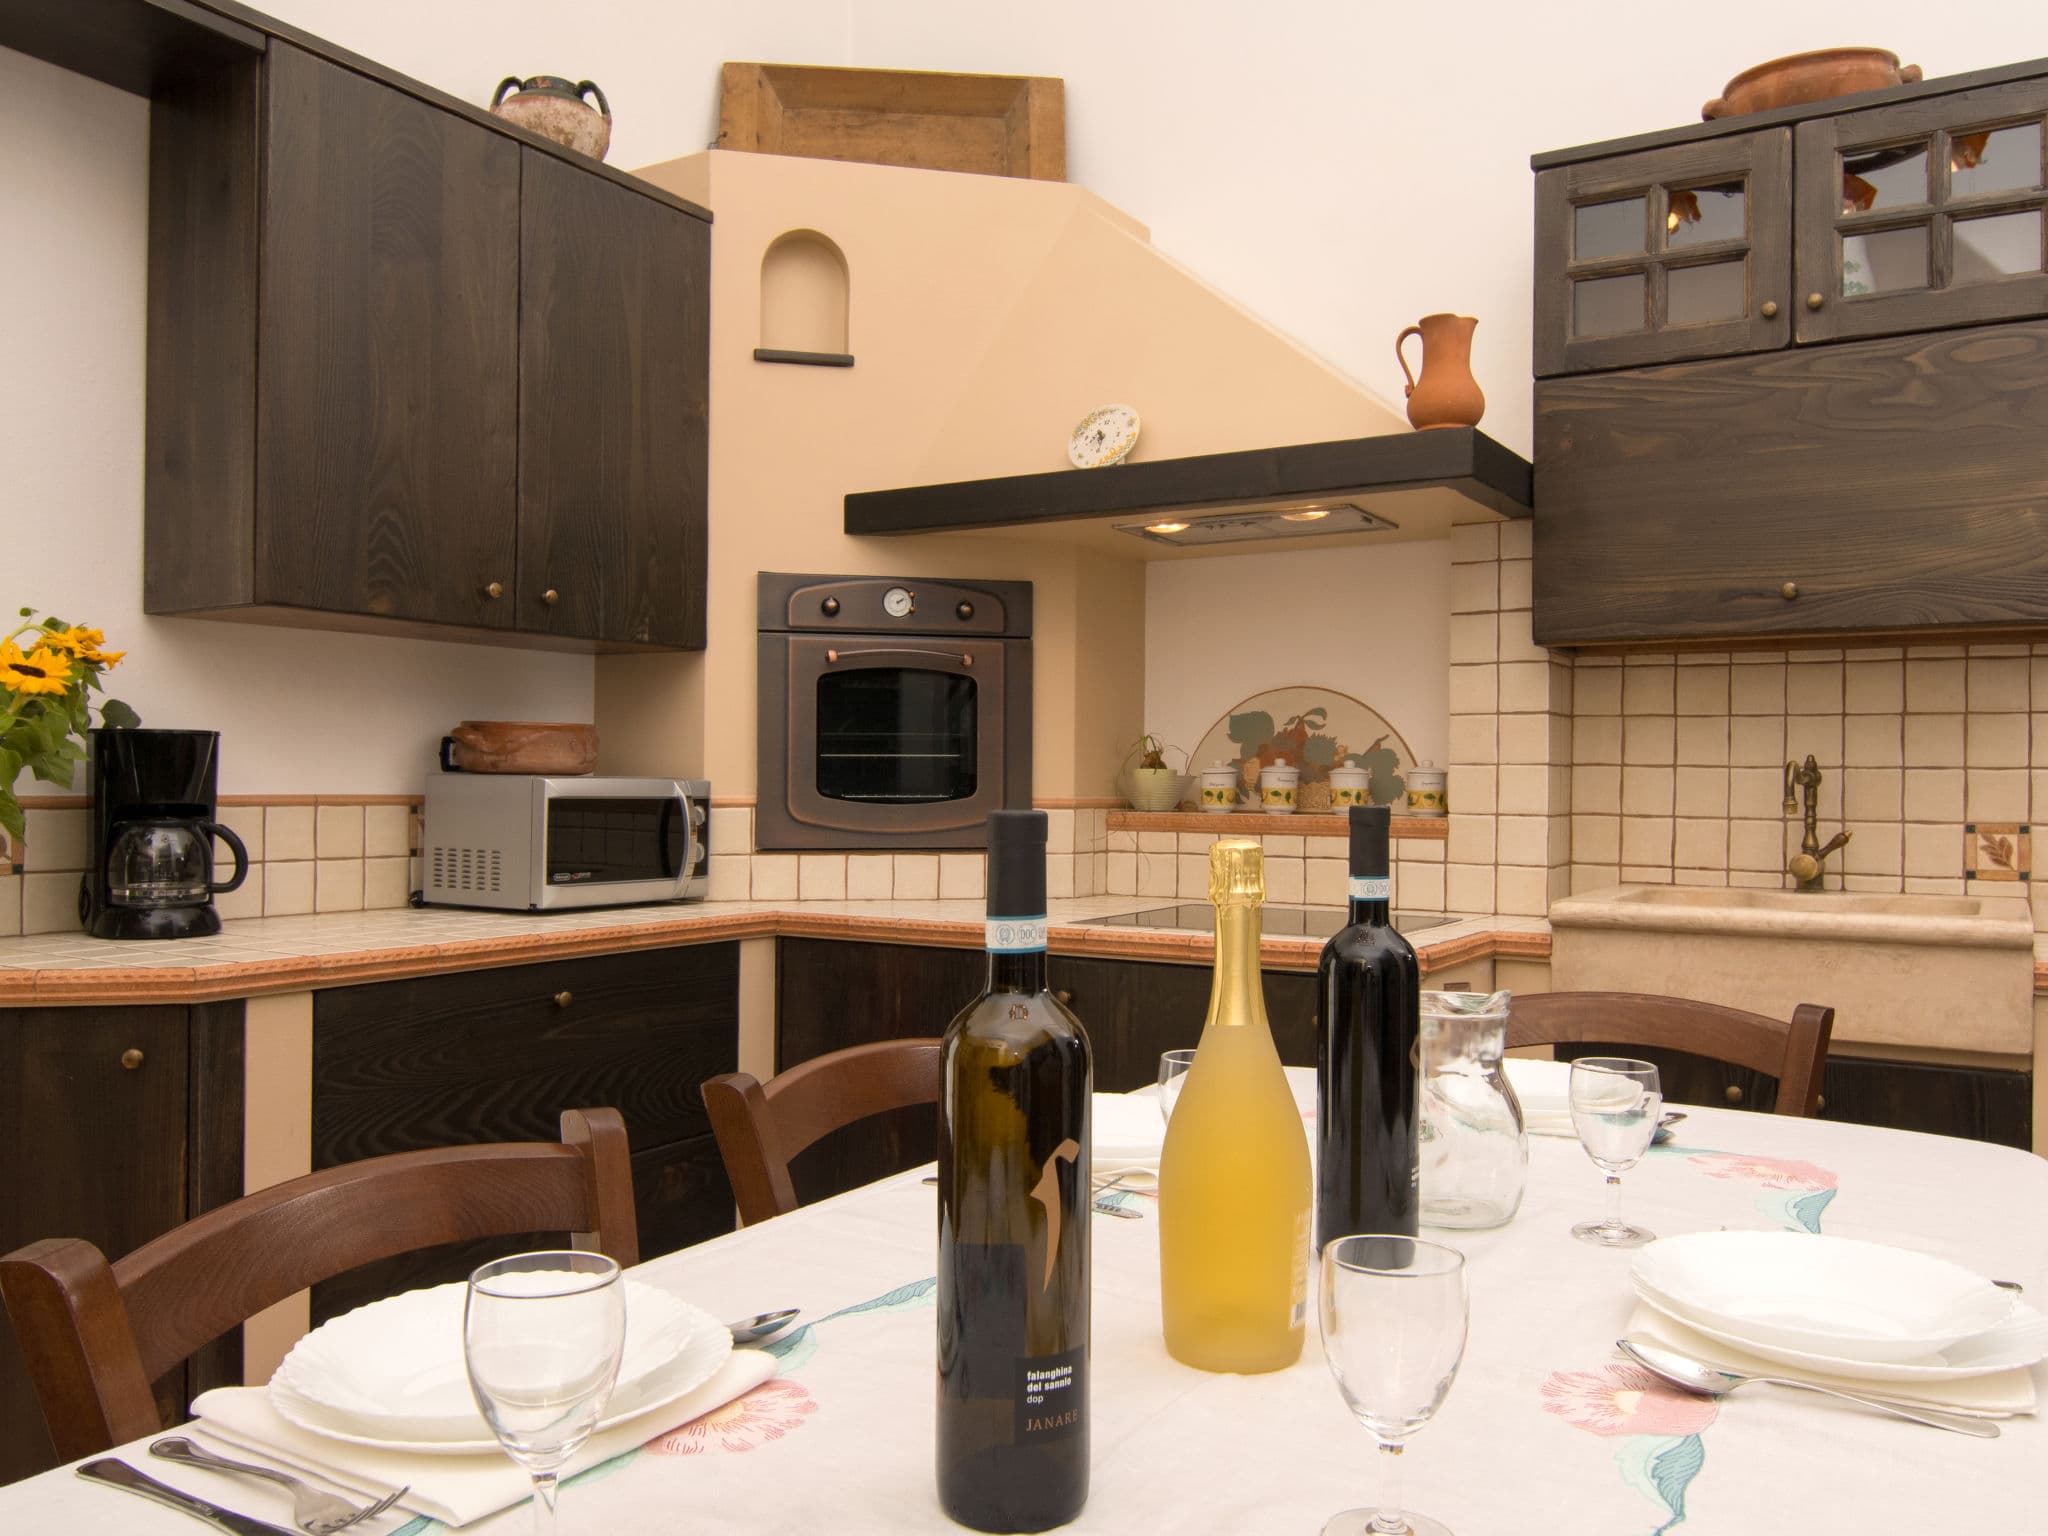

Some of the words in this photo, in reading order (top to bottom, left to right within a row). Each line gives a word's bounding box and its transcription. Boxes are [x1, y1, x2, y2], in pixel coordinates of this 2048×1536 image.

[1027, 1365, 1072, 1381] falanghina
[1027, 1382, 1041, 1393] del
[1044, 1377, 1071, 1391] sannio
[1027, 1394, 1043, 1404] dop
[1026, 1409, 1078, 1432] JANARE
